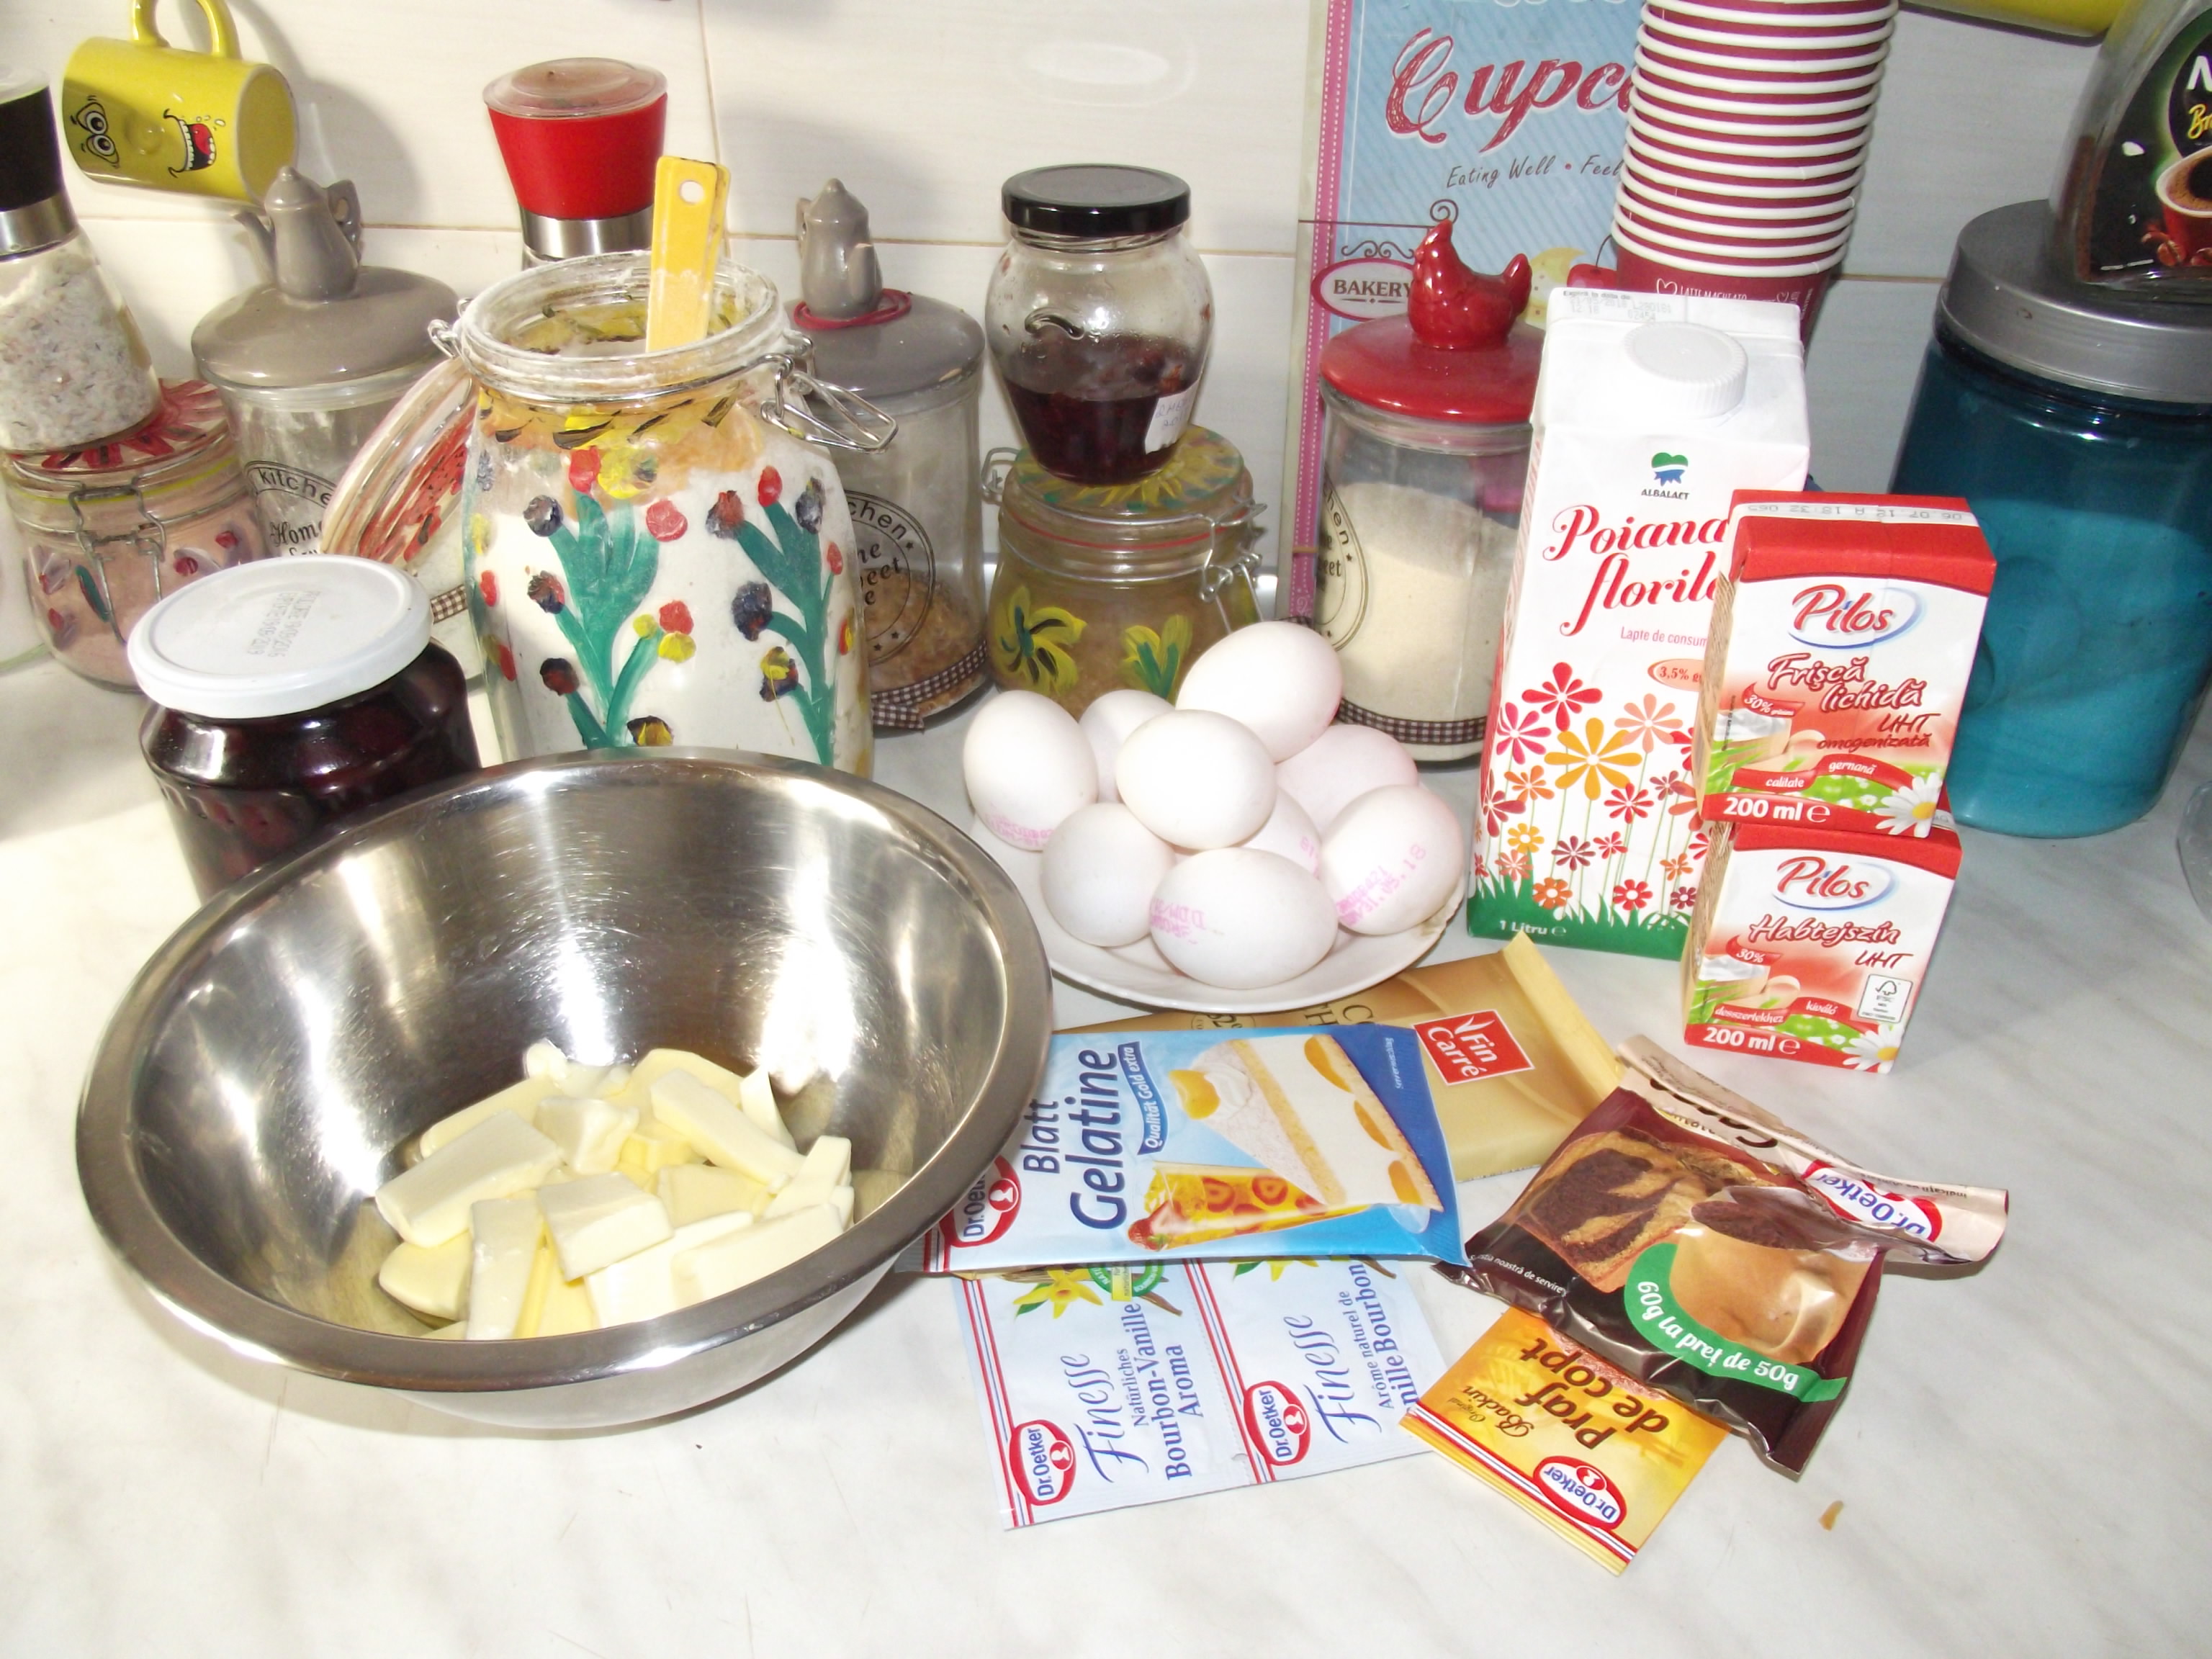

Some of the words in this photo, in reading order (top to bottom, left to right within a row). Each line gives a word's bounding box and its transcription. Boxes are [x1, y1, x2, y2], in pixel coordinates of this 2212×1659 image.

[1447, 166, 1500, 189] Eating
[1509, 155, 1556, 180] Well
[1333, 278, 1413, 297] BAKERY
[1640, 488, 1690, 500] ALBALACT
[1542, 504, 1729, 562] Poiana
[1791, 583, 1897, 634] Pilos
[1620, 626, 1649, 642] Lapte
[1652, 629, 1665, 642] de
[1659, 666, 1689, 680] 3,5%
[1743, 693, 1771, 714] 30%
[1819, 678, 1928, 714] lichidă
[1876, 713, 1942, 734] UHT
[1816, 733, 1931, 753] omogenizată
[1765, 776, 1804, 789] calitate
[1723, 796, 1769, 819] 200
[1773, 802, 1802, 822] ml
[1776, 855, 1871, 900] Pilos
[1498, 920, 1506, 930] 1
[1511, 922, 1548, 935] Litru
[1748, 913, 1902, 948] Habtejszín
[1735, 948, 1765, 963] 30%
[1854, 950, 1915, 970] UHT
[1804, 999, 1838, 1016] kiváló
[1427, 1026, 1488, 1077] Carré
[1460, 1033, 1498, 1062] Fin
[1703, 1026, 1746, 1047] 200
[1747, 1031, 1775, 1052] ml
[1121, 1046, 1141, 1071] extra
[1132, 1071, 1154, 1099] Gold
[1020, 1098, 1061, 1174] Blatt
[1065, 1049, 1128, 1231] Gelatine
[1141, 1097, 1163, 1150] Qualität
[1493, 1257, 1525, 1276] noastră
[1524, 1269, 1536, 1280] de
[1337, 1290, 1353, 1307] de
[1348, 1263, 1399, 1354] Bourbon
[1342, 1308, 1374, 1359] naturel
[1637, 1281, 1665, 1321] 60g
[1658, 1315, 1684, 1339] la
[1674, 1331, 1724, 1367] preț
[1722, 1352, 1752, 1370] de
[1753, 1359, 1800, 1392] 50g
[1164, 1344, 1205, 1419] Aroma
[1282, 1313, 1383, 1445] Finesse
[1367, 1359, 1395, 1410] Arôme
[1519, 1336, 1614, 1398] copt
[1116, 1347, 1150, 1427] Natürliches
[1120, 1301, 1192, 1481] Bourbon-Vanille
[1060, 1352, 1151, 1485] Finesse
[1462, 1384, 1534, 1438] Backin
[1513, 1382, 1617, 1450] Praf
[1612, 1394, 1671, 1435] de
